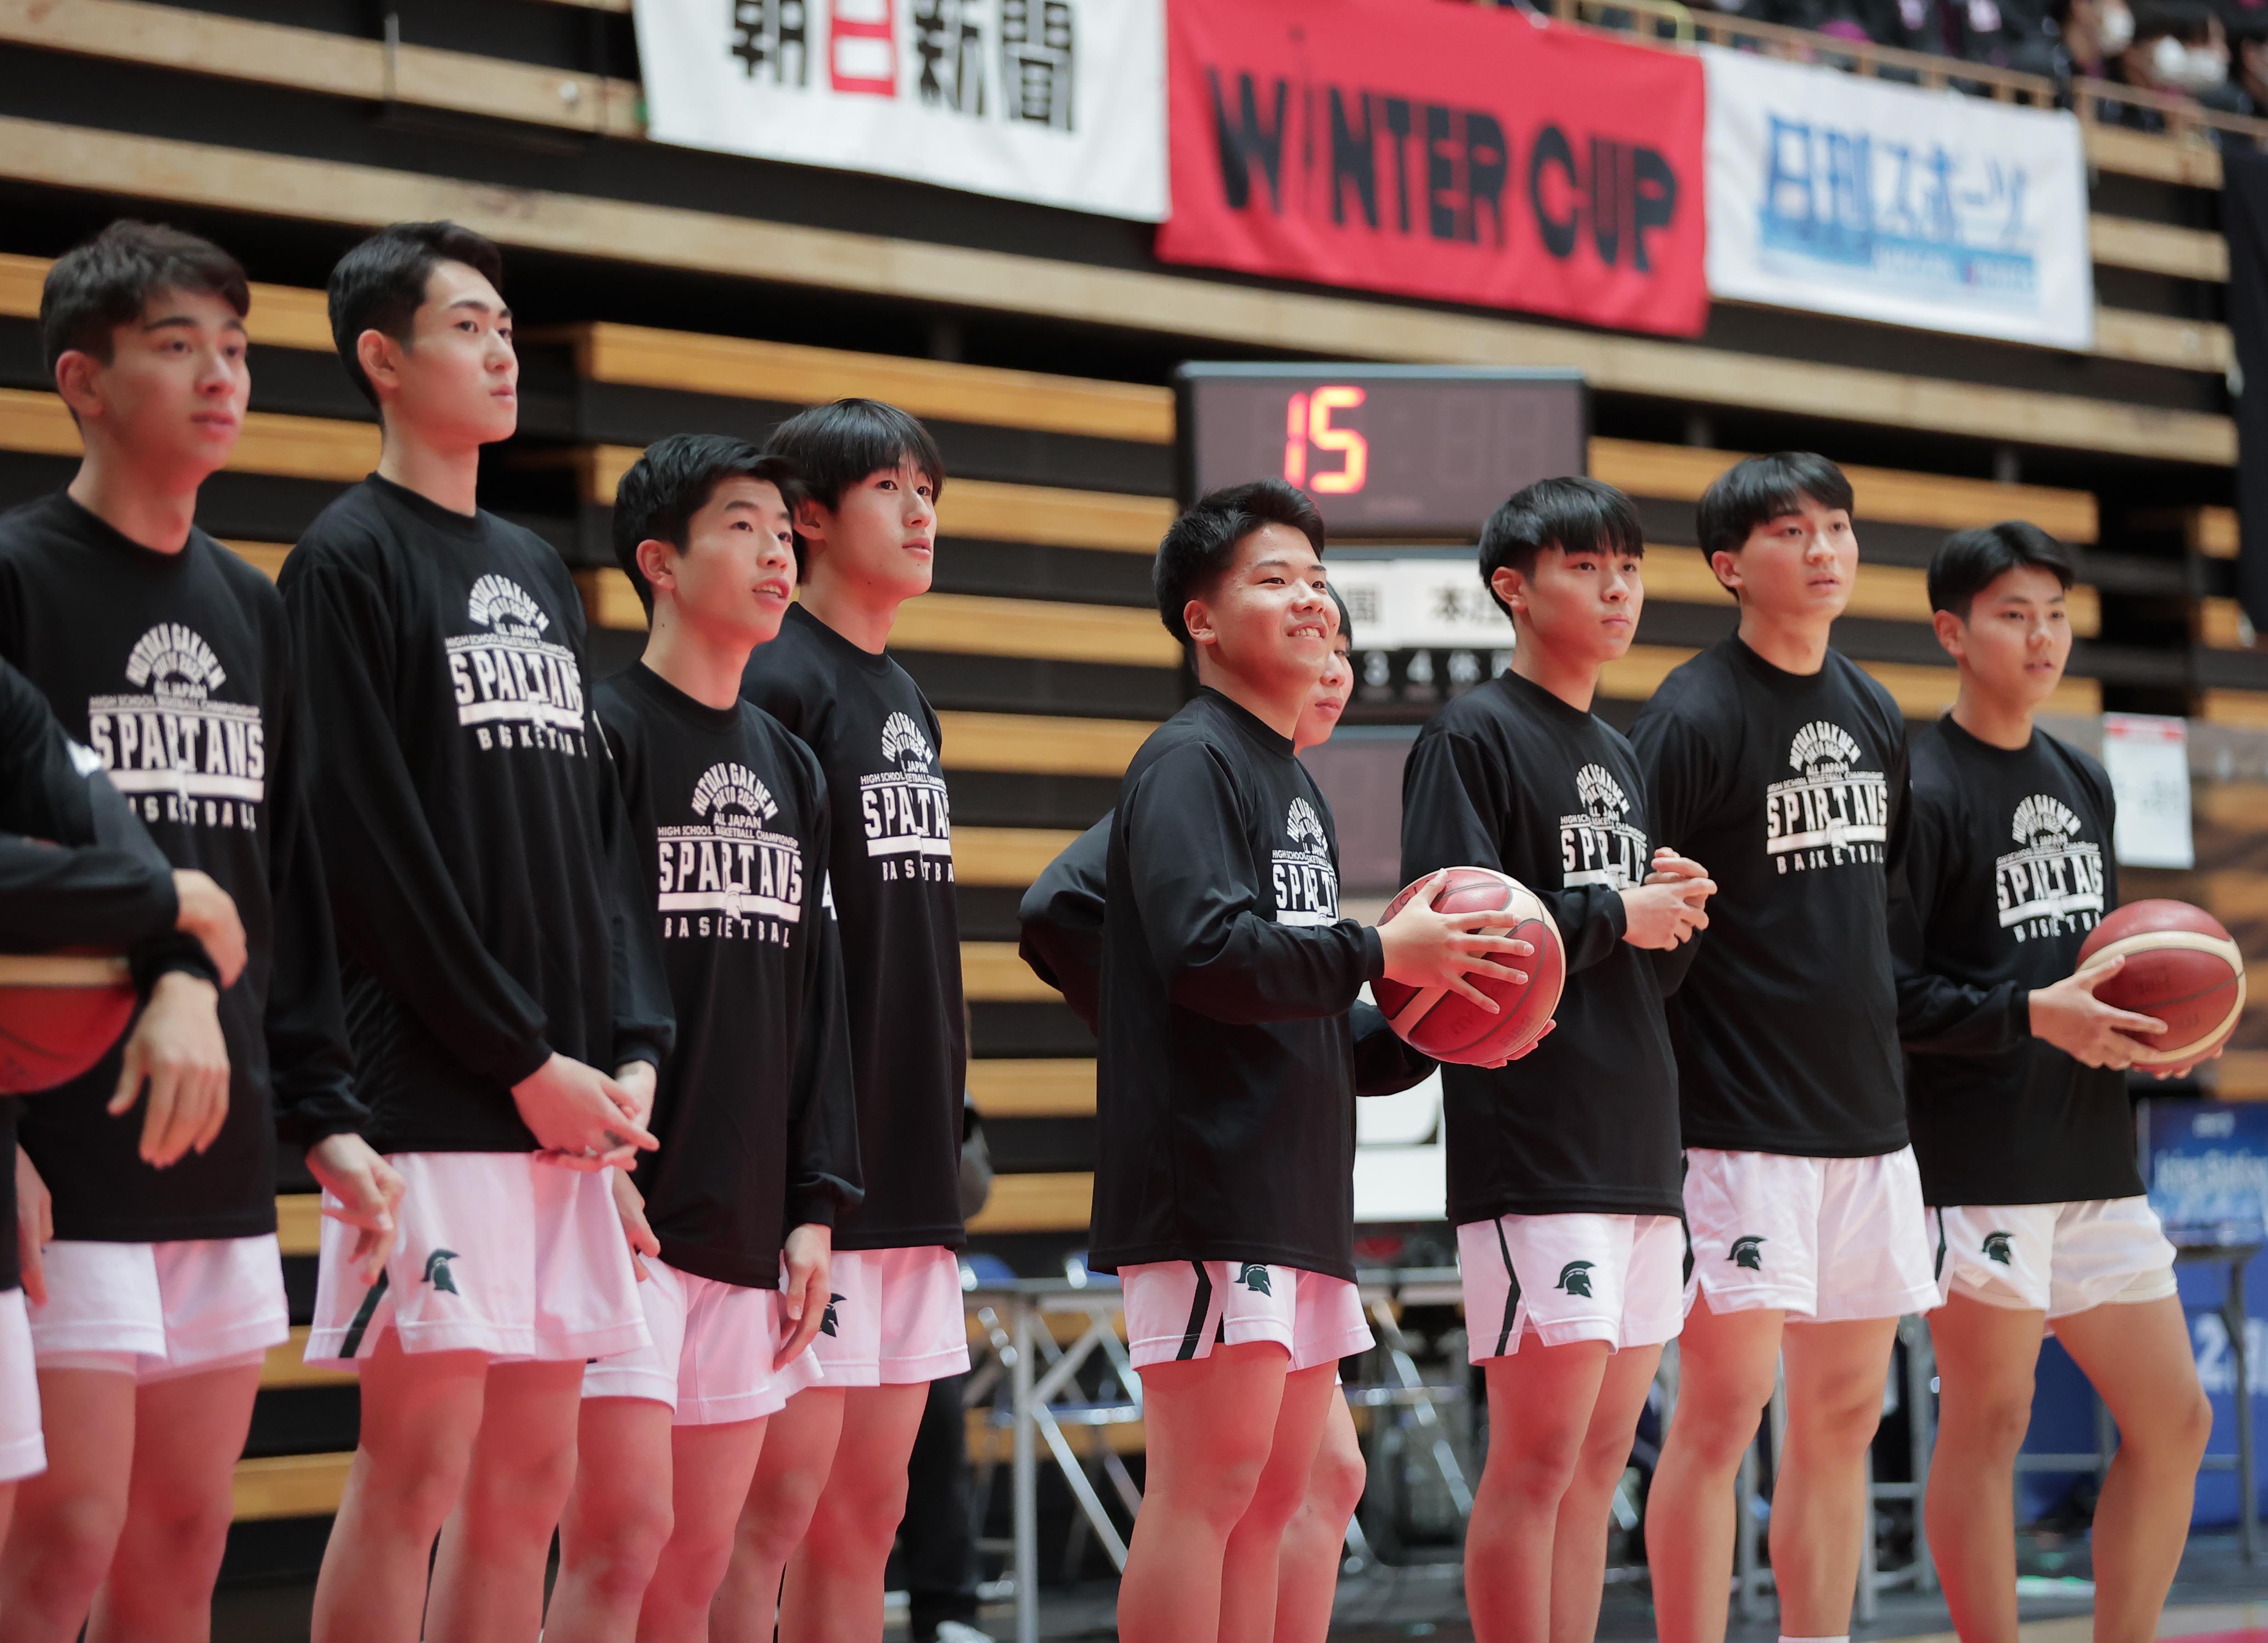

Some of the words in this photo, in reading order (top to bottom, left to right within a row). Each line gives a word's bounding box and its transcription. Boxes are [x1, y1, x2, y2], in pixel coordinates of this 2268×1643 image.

[1529, 123, 1681, 272] CUP
[1284, 386, 1368, 494] 15
[449, 649, 584, 715] SPARTANS
[90, 713, 265, 780] SPARTANS
[907, 760, 929, 774] JAPAN
[691, 762, 729, 817] HOTOKU
[729, 762, 779, 822] GAKUEN
[737, 788, 759, 816] 2022
[860, 773, 881, 785] HIGH
[881, 771, 905, 782] SCHOOL
[658, 826, 681, 836] HIGH
[682, 826, 713, 836] SCHOOL
[714, 812, 726, 826] ALL
[728, 814, 762, 829] JAPAN
[1767, 784, 1888, 839] SPARTANS
[658, 842, 803, 905] SPARTANS
[1272, 850, 1287, 858] HIGH
[1286, 850, 1307, 860] SCHOOL
